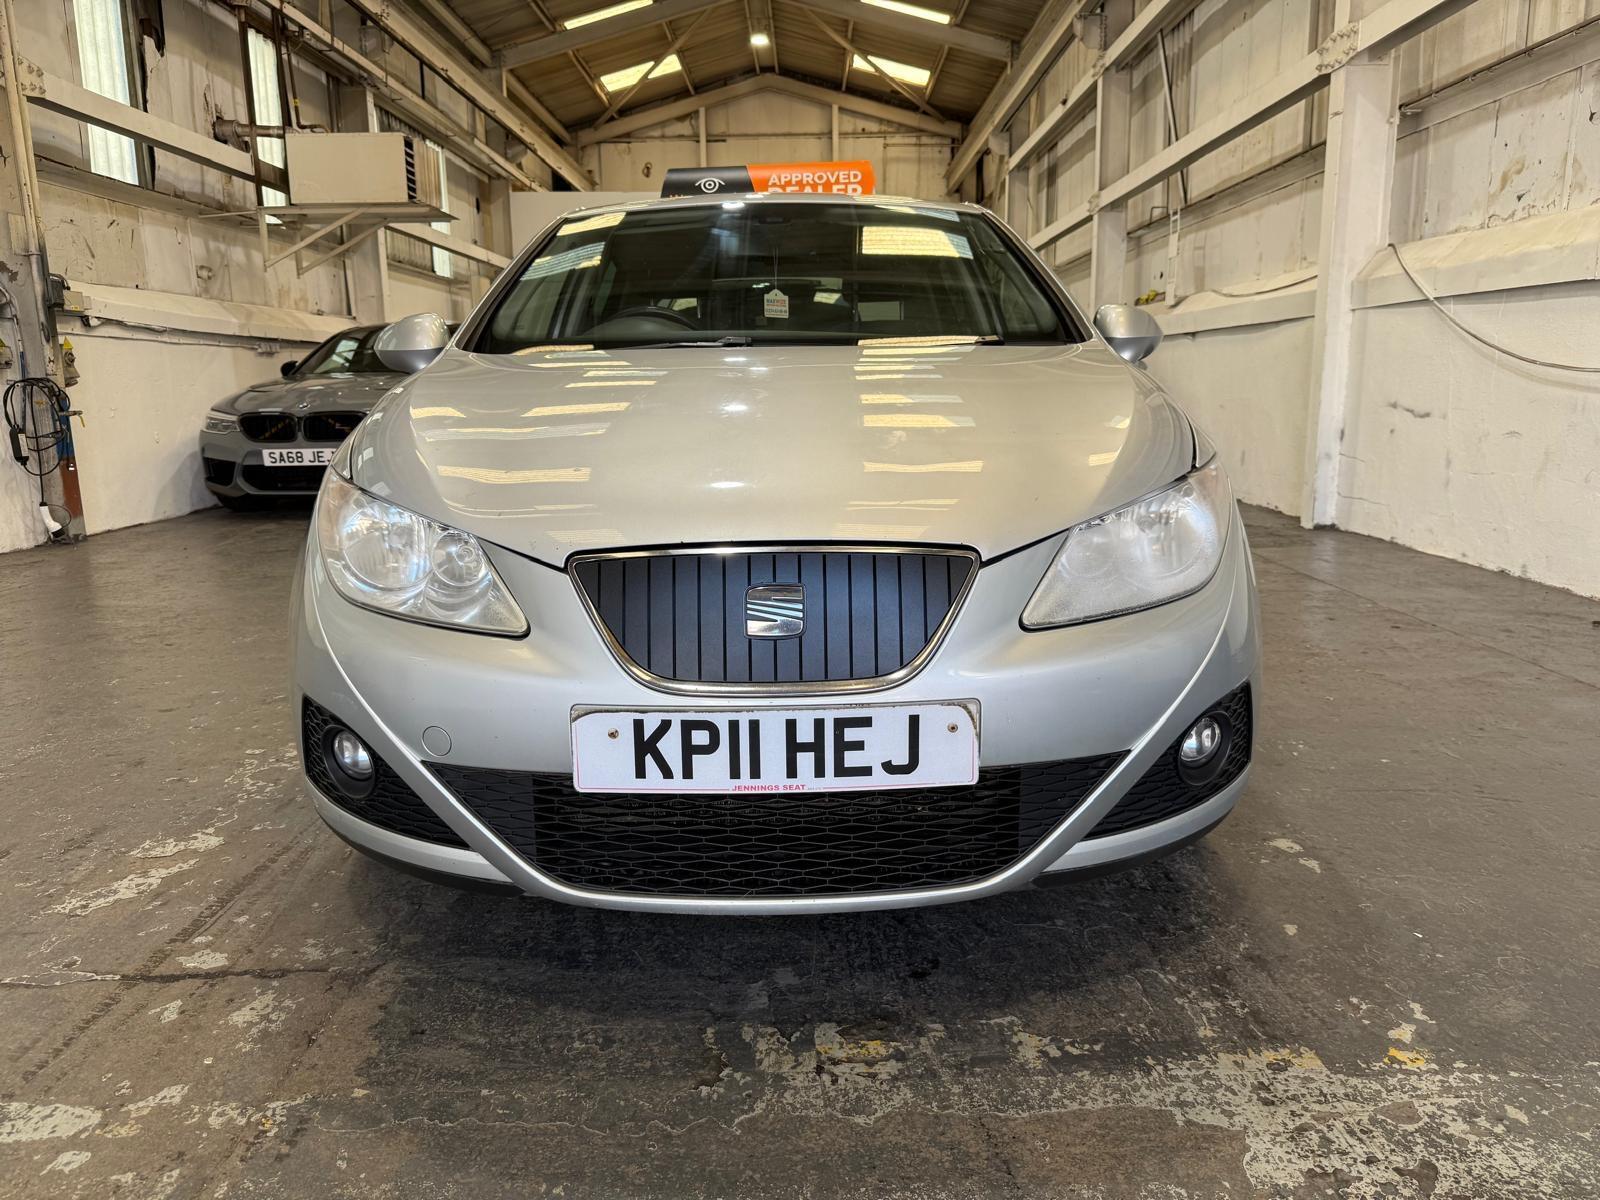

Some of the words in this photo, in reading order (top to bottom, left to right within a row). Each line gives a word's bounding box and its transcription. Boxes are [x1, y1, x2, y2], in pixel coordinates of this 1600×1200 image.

[768, 170, 862, 185] APPROVED
[269, 451, 304, 464] SA68
[633, 717, 761, 780] KP11
[785, 714, 921, 779] HEJ
[732, 784, 779, 792] JENNINGS
